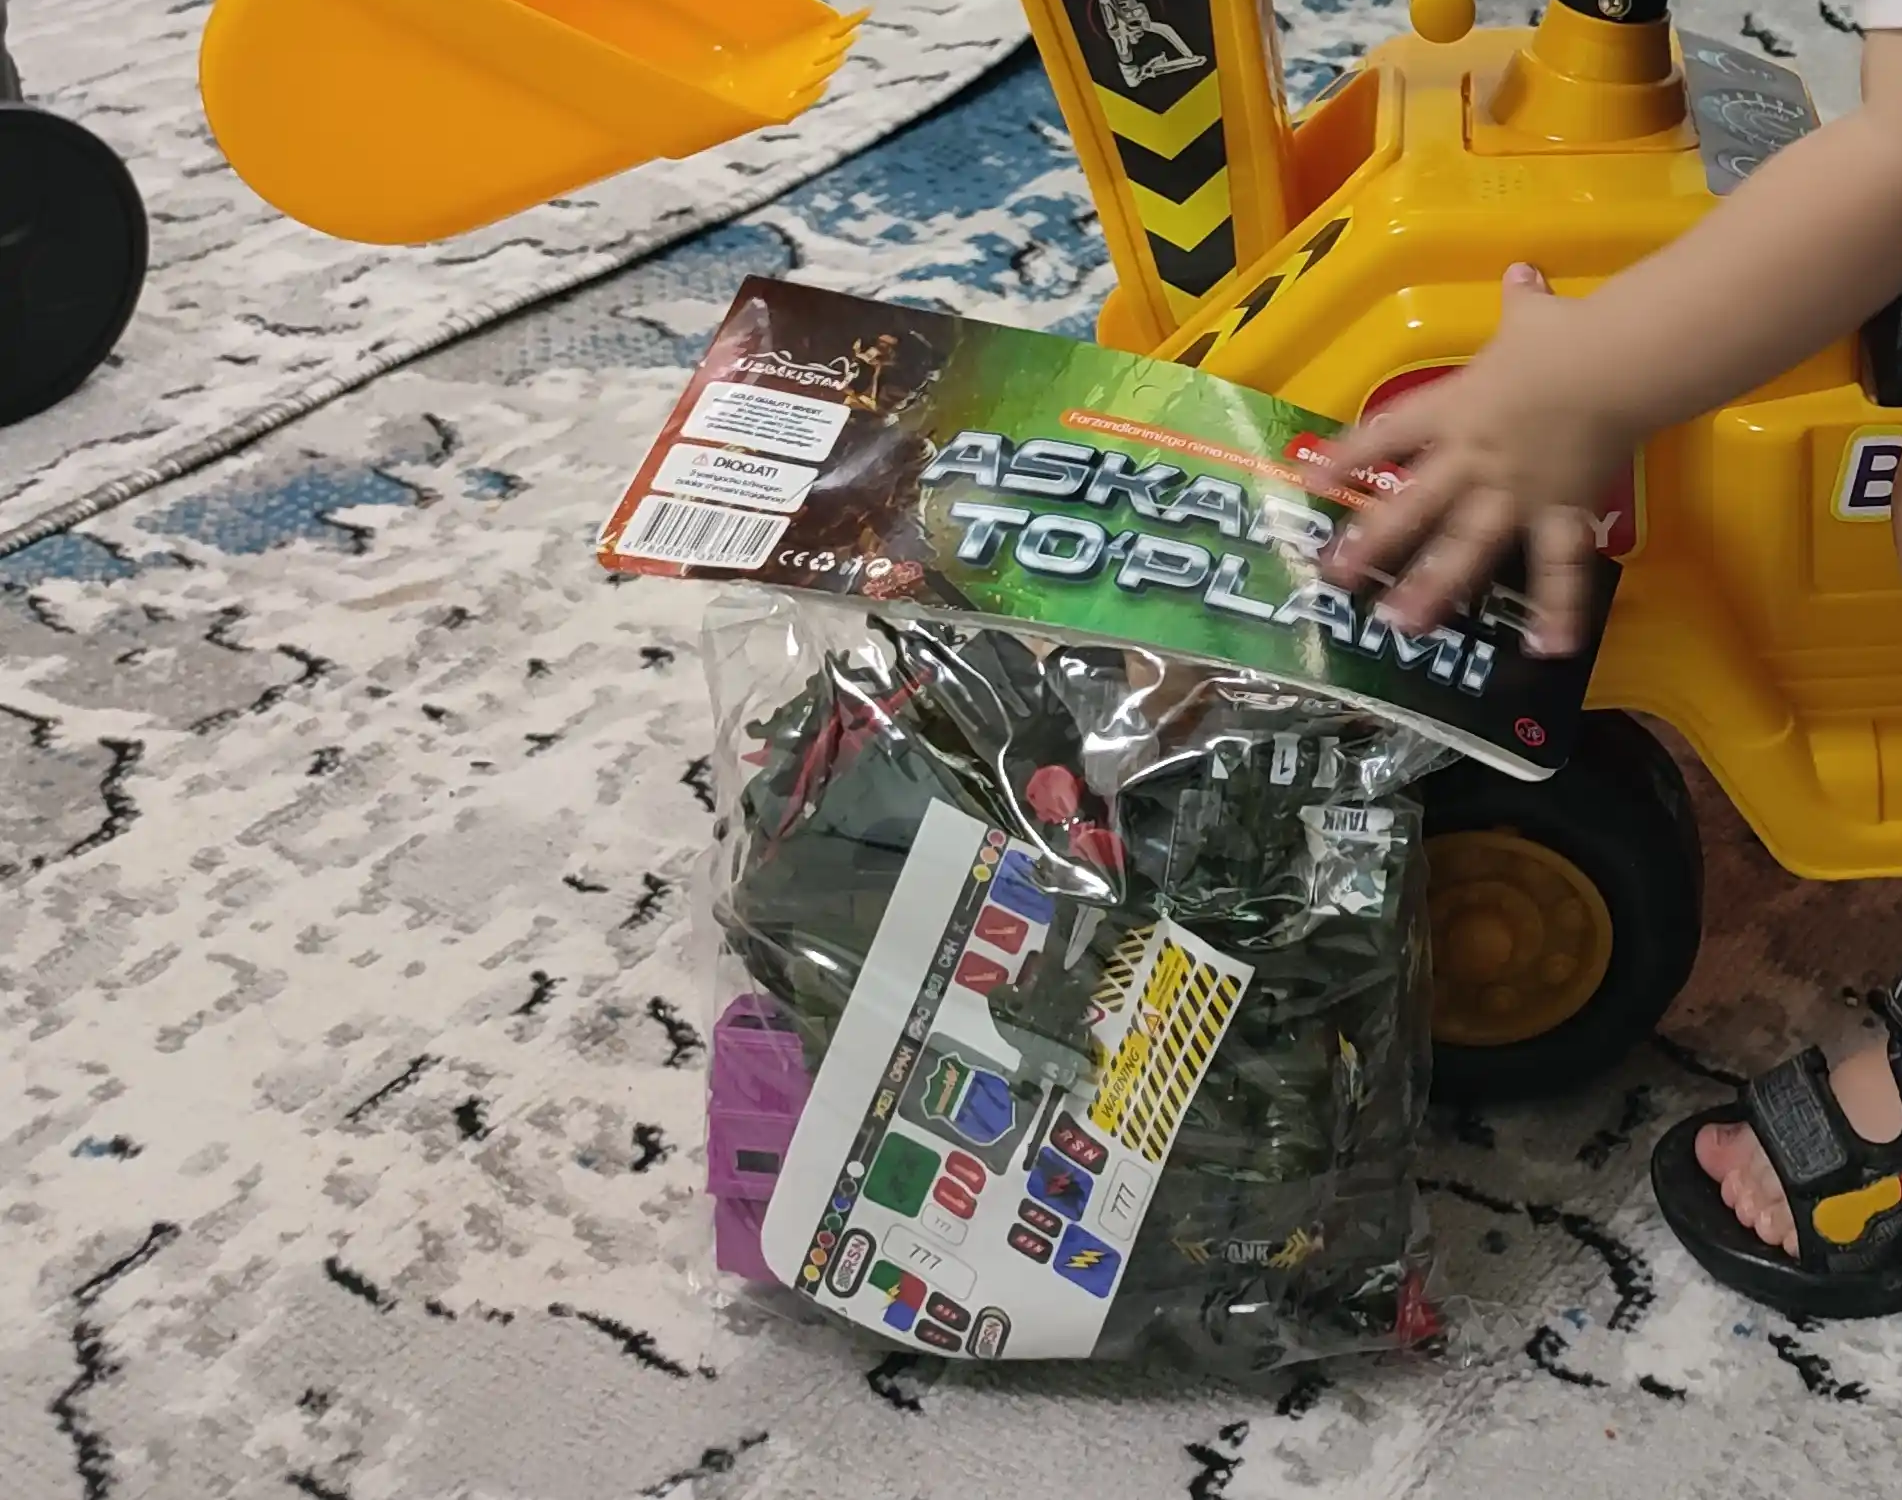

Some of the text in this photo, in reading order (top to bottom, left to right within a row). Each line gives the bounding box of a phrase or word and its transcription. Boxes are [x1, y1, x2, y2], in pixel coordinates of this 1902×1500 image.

[1322, 809, 1369, 833] TANK
[1101, 1046, 1140, 1120] WARNING
[1059, 1127, 1098, 1161] RSN
[1110, 1181, 1136, 1220] 777
[909, 1242, 943, 1270] 777
